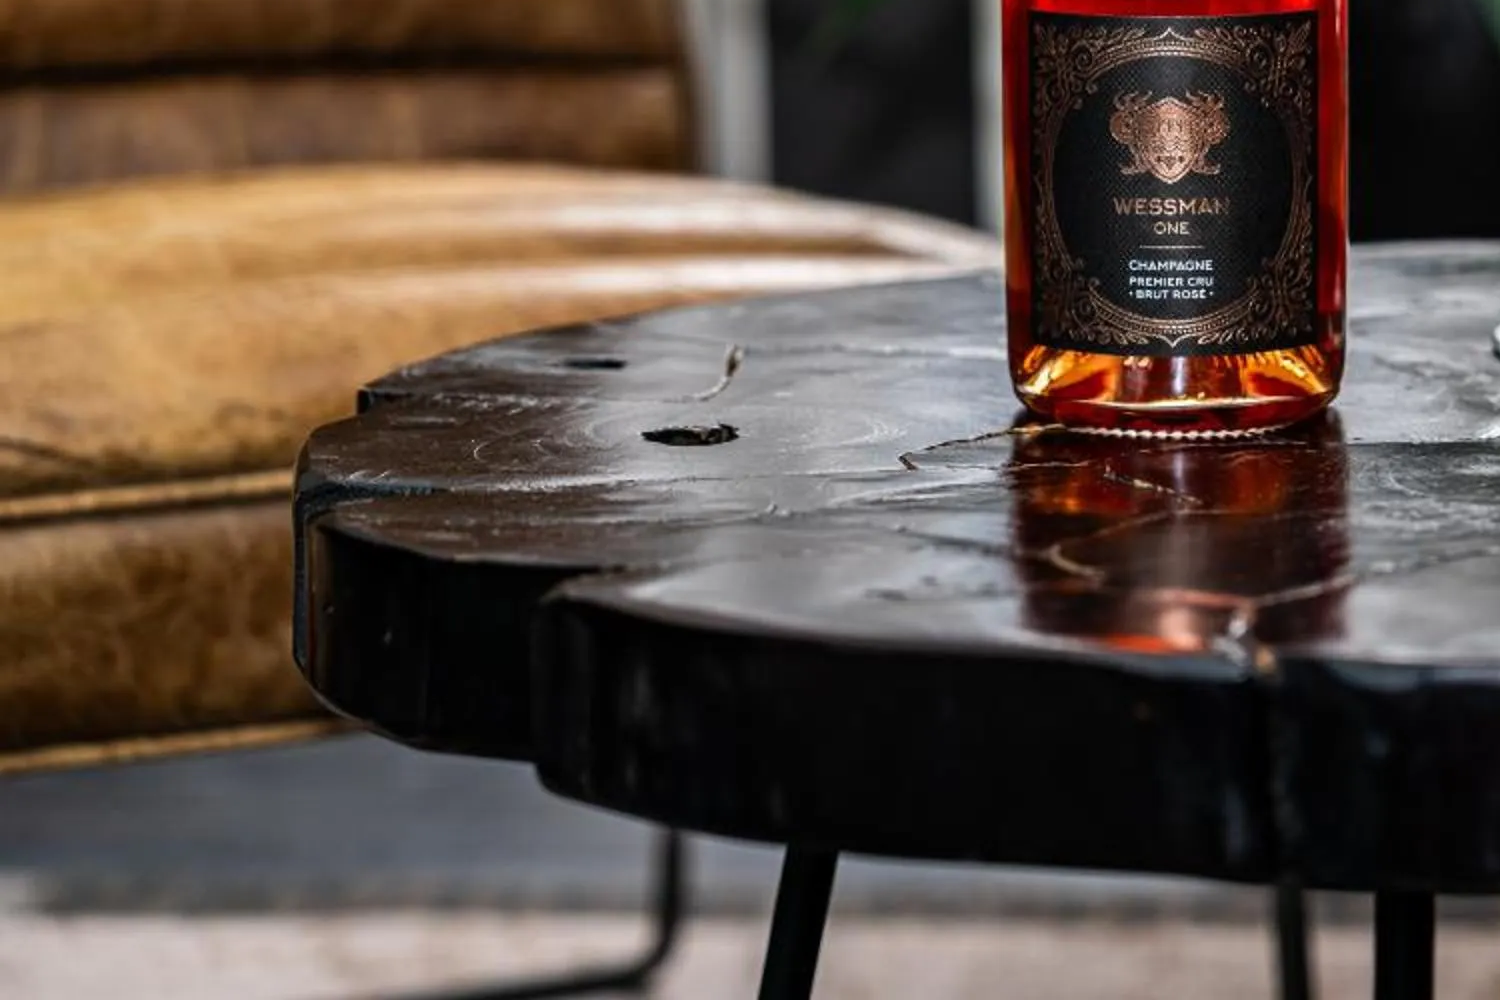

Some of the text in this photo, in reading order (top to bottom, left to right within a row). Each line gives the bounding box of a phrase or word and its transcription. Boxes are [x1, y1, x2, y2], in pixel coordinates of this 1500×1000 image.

[1114, 197, 1230, 216] WESSMAN
[1153, 221, 1190, 235] ONE
[1128, 259, 1213, 272] CHAMPAGNE
[1129, 276, 1214, 287] PREMIER CRU
[1136, 289, 1169, 300] BRUT
